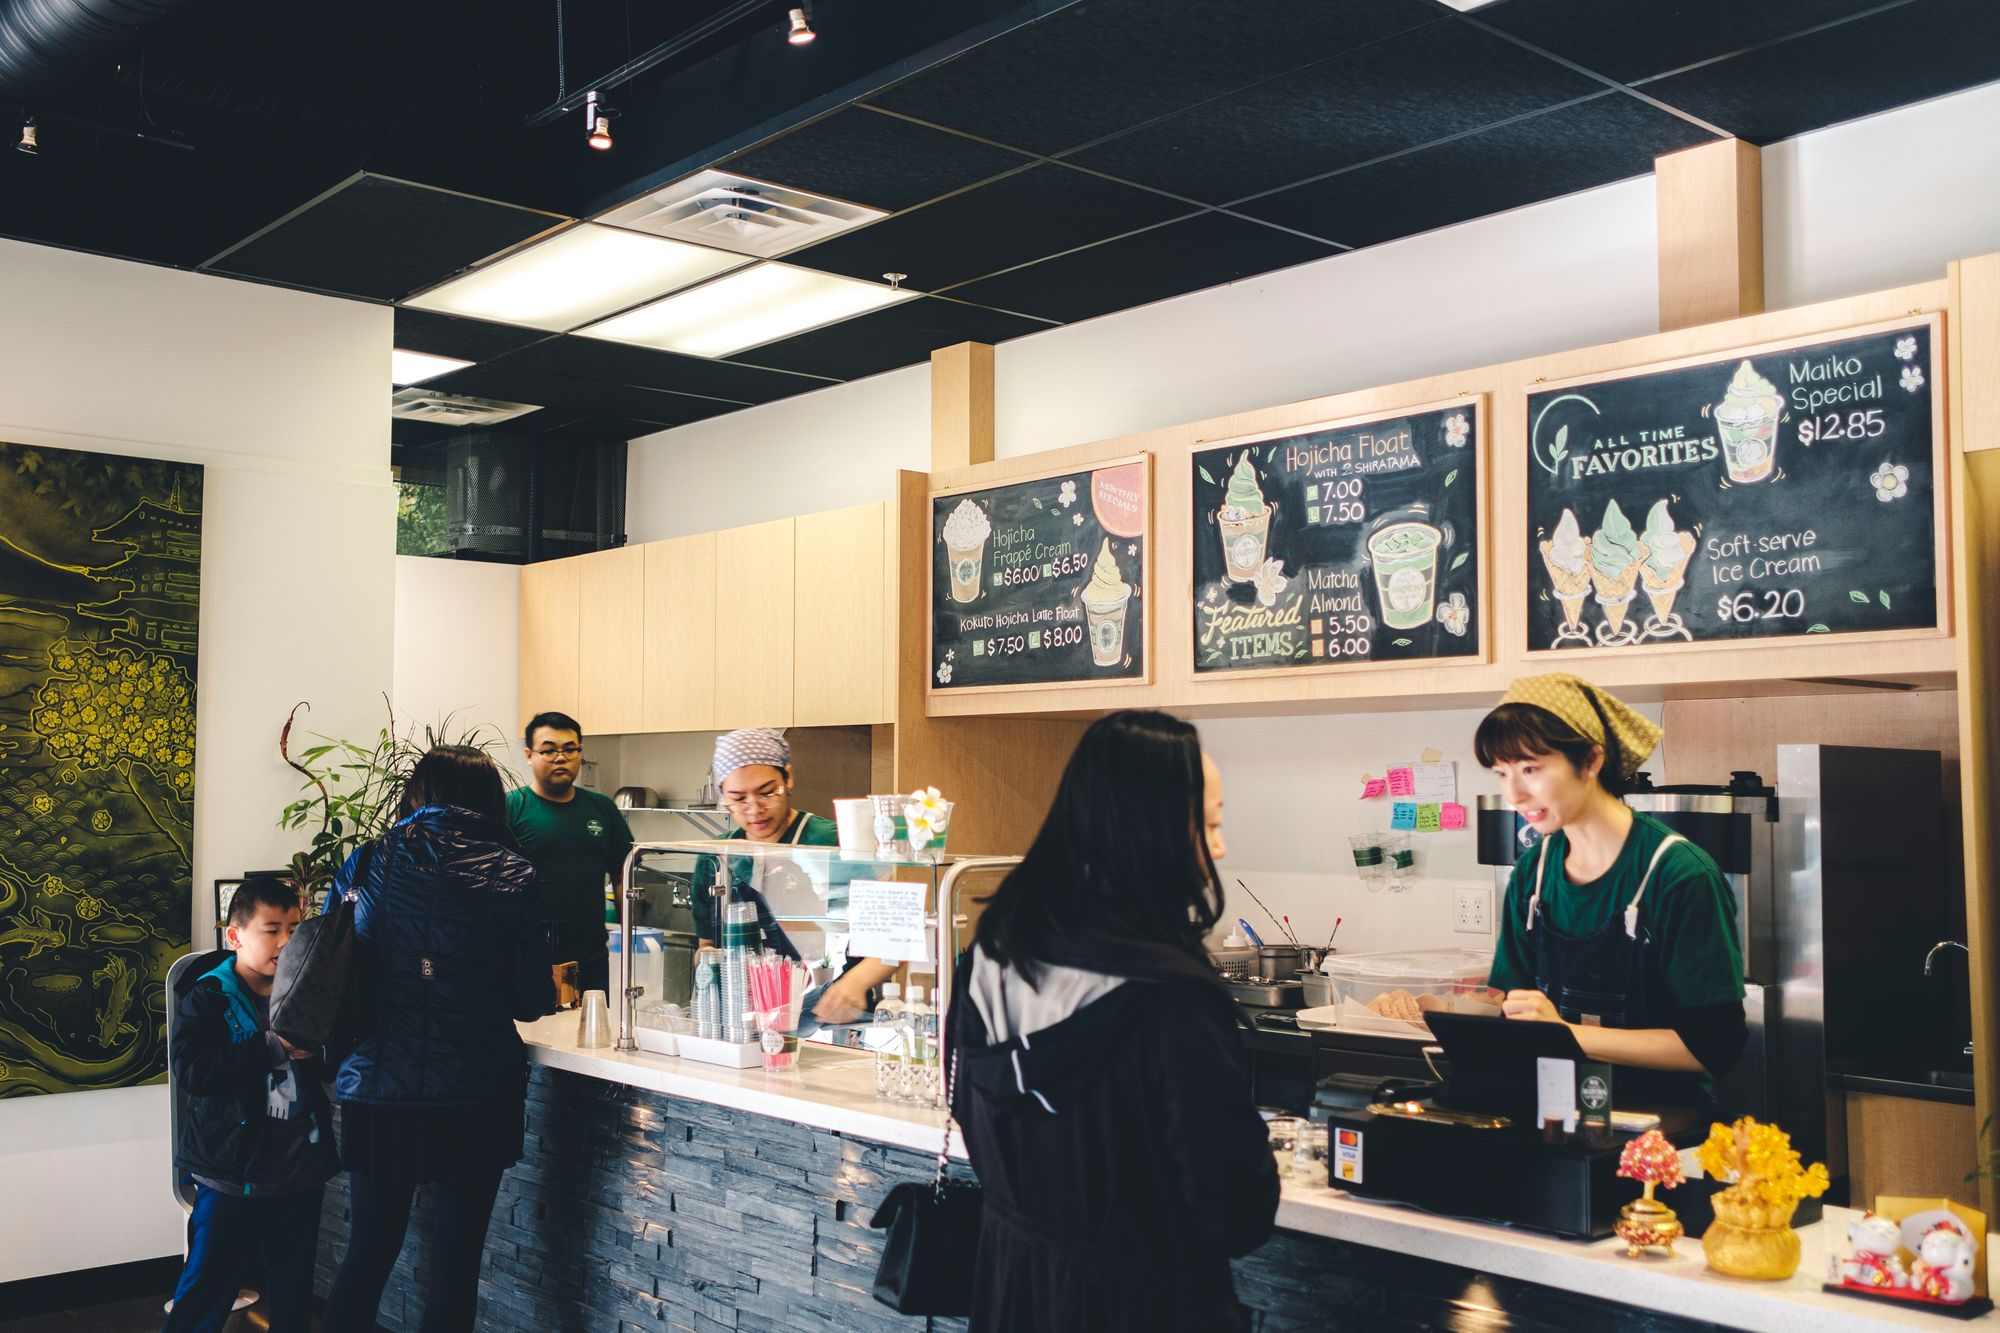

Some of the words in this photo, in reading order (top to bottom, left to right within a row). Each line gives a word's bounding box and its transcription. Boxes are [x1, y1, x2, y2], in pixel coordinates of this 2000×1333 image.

[1789, 354, 1862, 384] Maiko
[1792, 375, 1882, 414] Special
[1594, 435, 1629, 450] ALL
[1639, 426, 1685, 442] TIME
[1798, 409, 1885, 447] $12.85
[1286, 441, 1352, 477] Hojicha
[1359, 432, 1410, 459] Float
[1314, 468, 1337, 479] WITH
[1354, 454, 1421, 474] SHIRATAMA
[1571, 436, 1719, 480] FAVORITES
[1322, 478, 1362, 502] 7.00
[1322, 502, 1365, 523] 7.50
[993, 524, 1035, 551] Hojicha
[993, 544, 1032, 569] Frappé
[1035, 542, 1072, 560] Cream
[1308, 569, 1358, 590] Matcha
[1713, 564, 1744, 585] Ice
[1749, 555, 1820, 579] Cream
[1310, 591, 1362, 613] Almond
[1717, 589, 1805, 622] $6.20
[995, 612, 1029, 629] Hojicha
[1032, 608, 1054, 623] Latte
[1055, 606, 1080, 621] Float
[1200, 594, 1303, 645] Featured
[1329, 615, 1370, 635] 5.50
[987, 635, 1025, 656] $7.50
[1043, 625, 1083, 649] $8.00
[1229, 631, 1294, 660] ITEMS
[1328, 637, 1370, 657] 6.00
